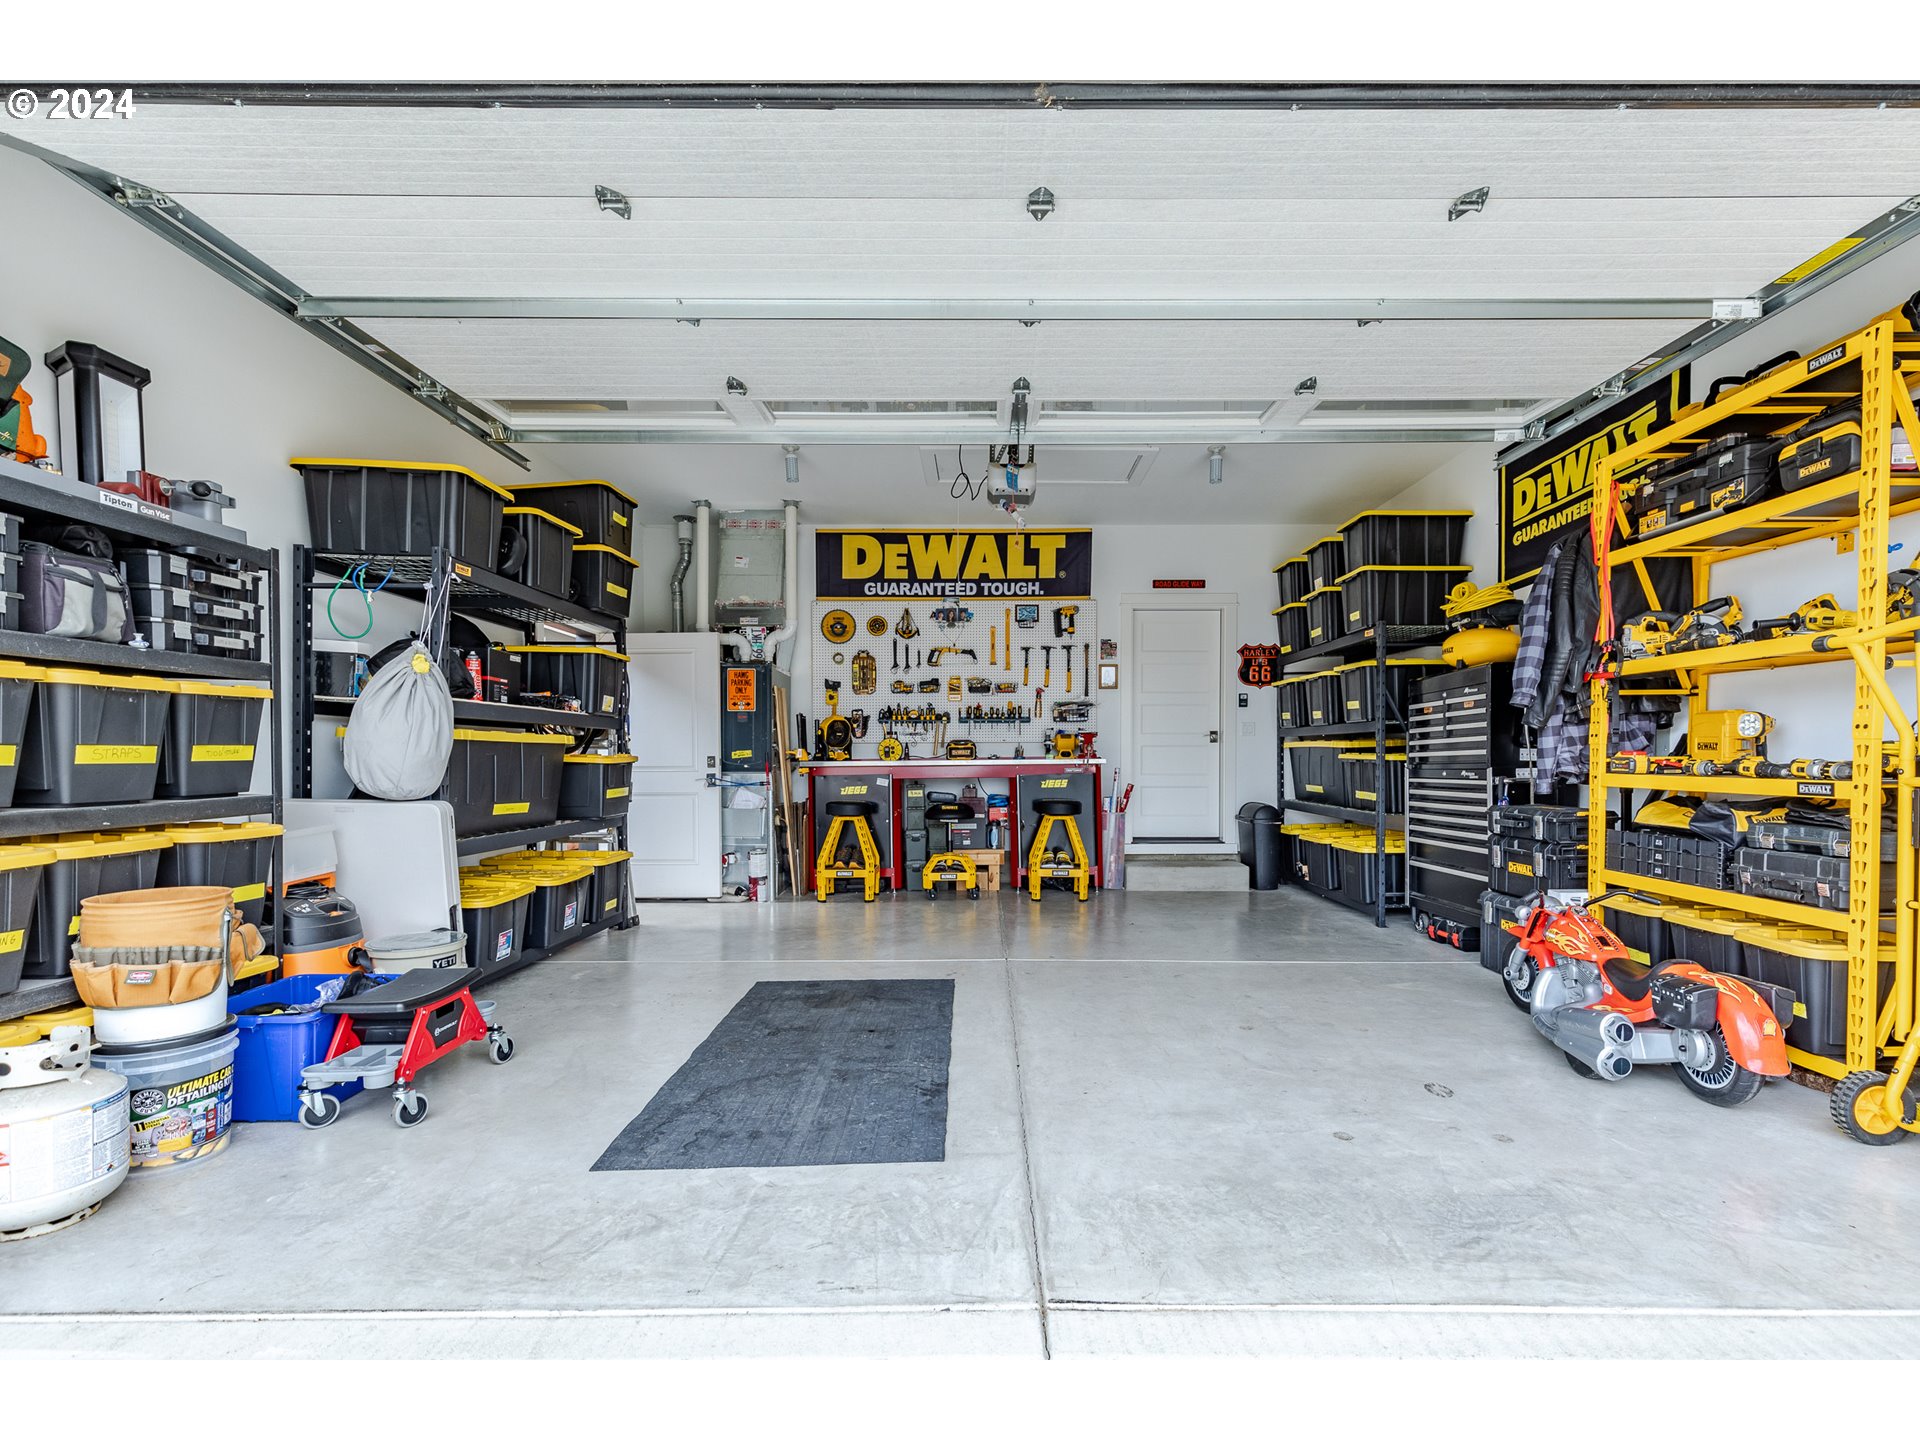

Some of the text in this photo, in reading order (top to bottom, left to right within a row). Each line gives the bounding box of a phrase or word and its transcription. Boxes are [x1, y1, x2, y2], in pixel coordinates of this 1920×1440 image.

[1809, 346, 1843, 371] DEWALT
[103, 493, 133, 509] Tipton
[140, 505, 155, 516] Gun
[842, 534, 1066, 579] DEWALT
[864, 582, 1044, 596] GUARANTEED TOUGH.
[1249, 666, 1271, 682] 66
[731, 679, 752, 687] PARKING
[735, 686, 747, 694] ONLY
[1697, 742, 1719, 751] DEWALT
[93, 748, 142, 760] STRAPS
[1041, 779, 1068, 788] JEGS
[1799, 784, 1832, 795] DEWALT
[840, 785, 868, 795] JEGS
[1509, 862, 1534, 876] DEWAL
[434, 956, 456, 968] YETI
[167, 1071, 219, 1098] ULTIMATE
[167, 1081, 224, 1109] DETAILING
[133, 1121, 146, 1132] 11
